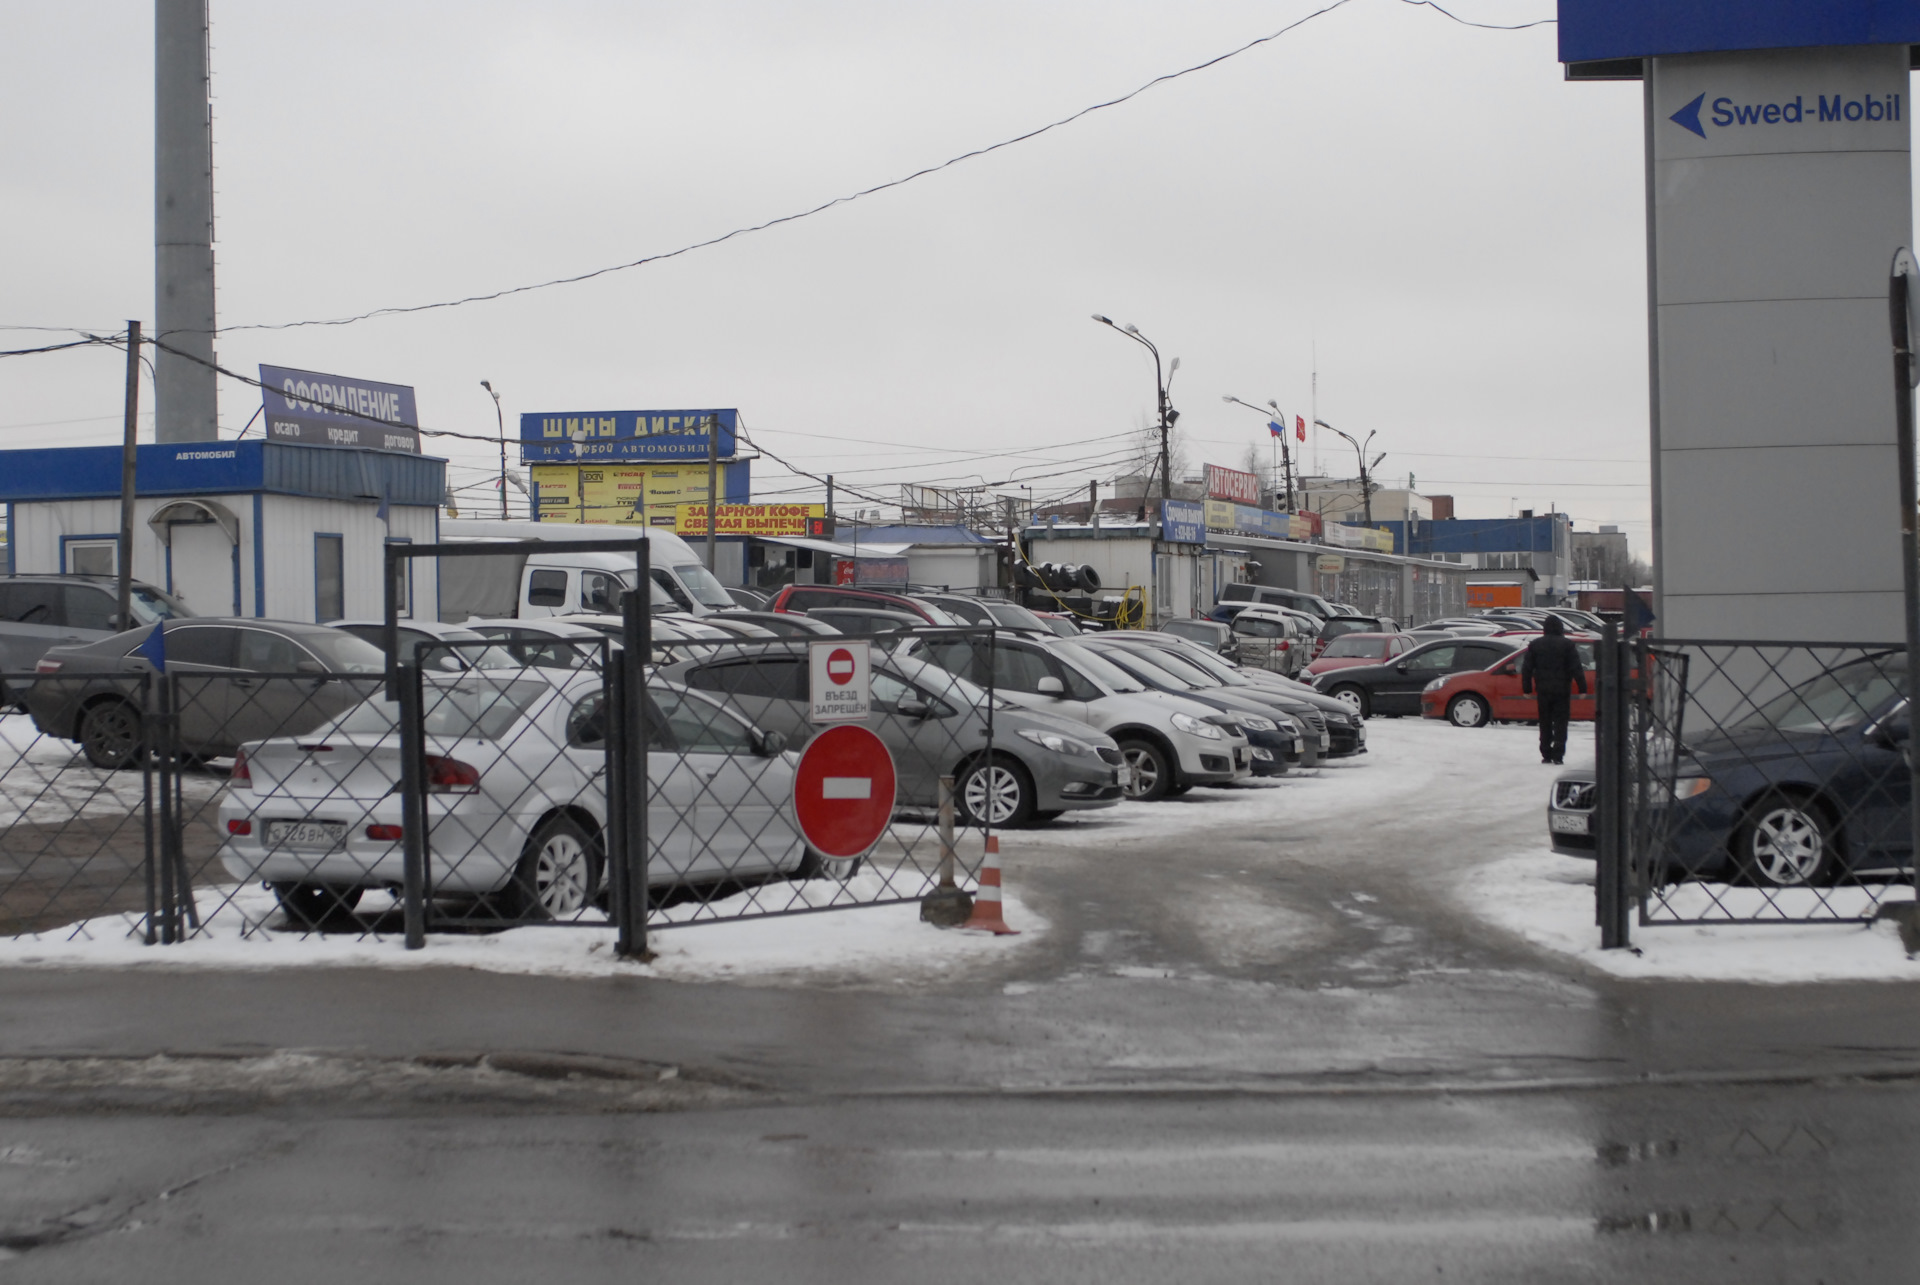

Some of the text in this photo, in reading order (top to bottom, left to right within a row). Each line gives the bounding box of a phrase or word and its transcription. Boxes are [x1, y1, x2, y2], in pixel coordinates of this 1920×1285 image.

[1711, 94, 1901, 127] Swed-Mobil
[284, 377, 401, 422] ОФОРМЛЕНИЕ
[543, 416, 712, 438] ШИНЫ ДИСКИ
[274, 421, 415, 453] осаго кредит договор
[176, 450, 236, 461] АВТОМОБИЛ
[543, 447, 561, 455] НА
[621, 444, 712, 454] АВТОМОБИЛ
[1208, 465, 1257, 501] АВТОСЕРВИС
[688, 506, 810, 517] ЗААРНОЙ КОФЕ
[746, 518, 807, 529] ВЫПЕЧК
[825, 691, 857, 701] ВЪЕЗД
